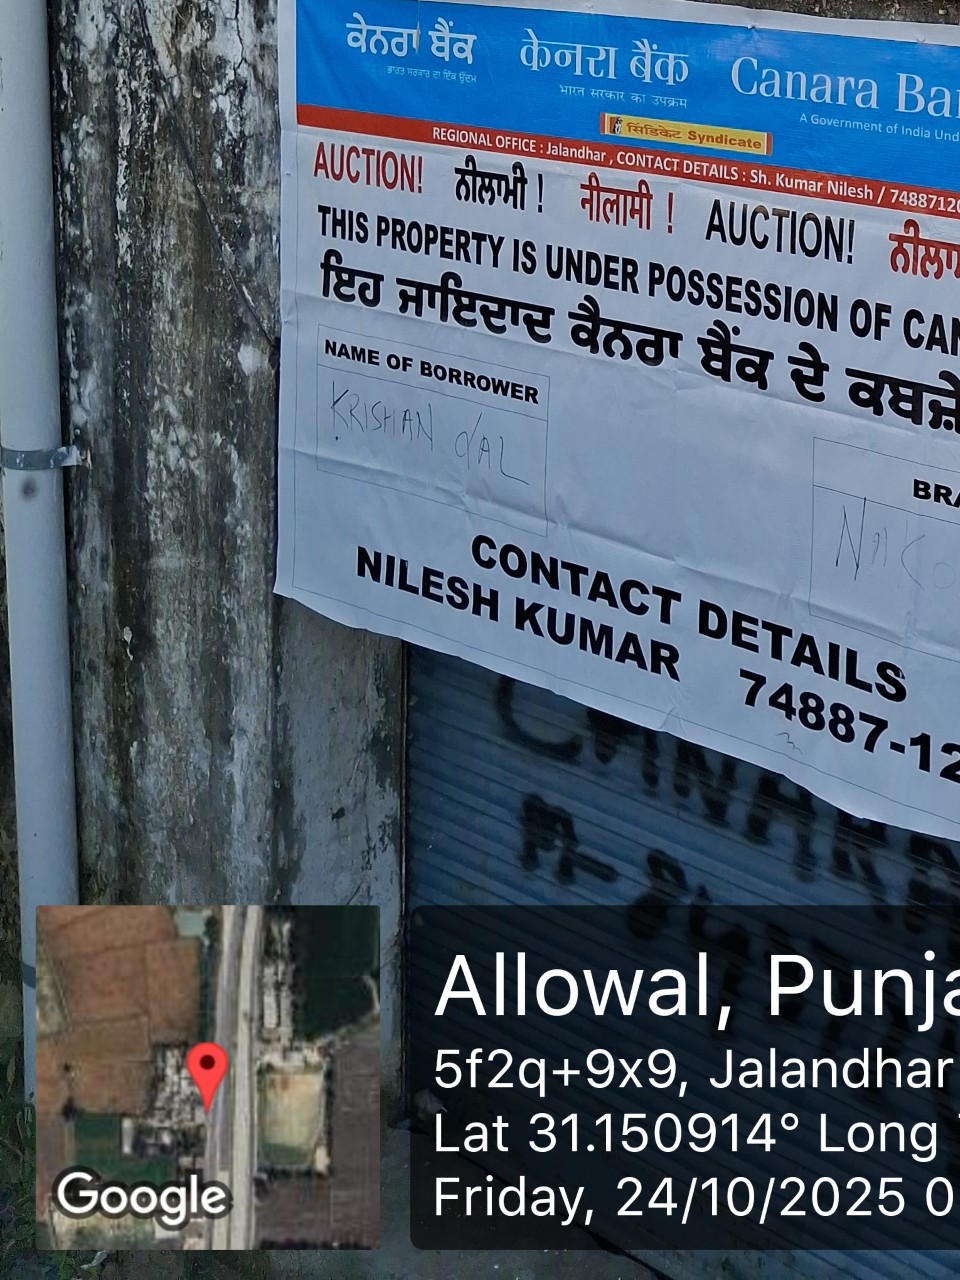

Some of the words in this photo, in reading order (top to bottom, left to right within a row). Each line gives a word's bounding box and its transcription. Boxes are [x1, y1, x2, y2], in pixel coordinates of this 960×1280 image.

[428, 17, 477, 64] ਬੈਂਕ
[520, 28, 618, 79] केनरा
[630, 38, 689, 86] बैंक
[560, 84, 585, 97] भारत
[590, 88, 624, 102] सरकार
[631, 92, 645, 104] का
[653, 95, 687, 109] उपक्रम
[731, 56, 880, 111] Canara
[688, 130, 762, 149] Syndicate
[800, 112, 808, 123] A
[812, 113, 882, 133] Government
[885, 122, 898, 134] of
[901, 123, 931, 139] India
[313, 140, 423, 194] AUCTION!
[432, 127, 492, 147] REGIONAL
[495, 136, 536, 153] OFFICE
[546, 143, 606, 162] Jalandhar
[616, 151, 679, 173] CONTACT
[683, 160, 738, 180] DETAILS
[749, 170, 772, 187] Sh.
[775, 172, 824, 192] Kumar
[827, 178, 873, 200] Nilesh
[454, 154, 528, 210] ਨੀਲਾਮੀ
[579, 172, 653, 230] नीलामी
[705, 198, 855, 264] AUCTION!
[317, 204, 369, 244] THIS
[376, 217, 505, 268] PROPERTY
[512, 238, 537, 274] IS
[546, 244, 639, 294] UNDER
[648, 262, 838, 333] POSSESSION
[850, 298, 891, 341] OF
[321, 248, 384, 307] ਇਹ
[396, 271, 555, 343] ਜਾਇਦਾਦ
[568, 294, 683, 367] ਕੈਨਰਾ
[697, 319, 774, 390] ਬੈਂਕ
[788, 342, 829, 403] ਦੇ
[324, 339, 380, 367] NAME
[386, 353, 413, 373] OF
[419, 360, 539, 405] BORROWER
[330, 381, 434, 452] KRISHAN
[356, 545, 499, 622] NILESH
[515, 596, 681, 679] KUMAR
[471, 534, 681, 625] CONTACT
[698, 599, 907, 703] DETAILS
